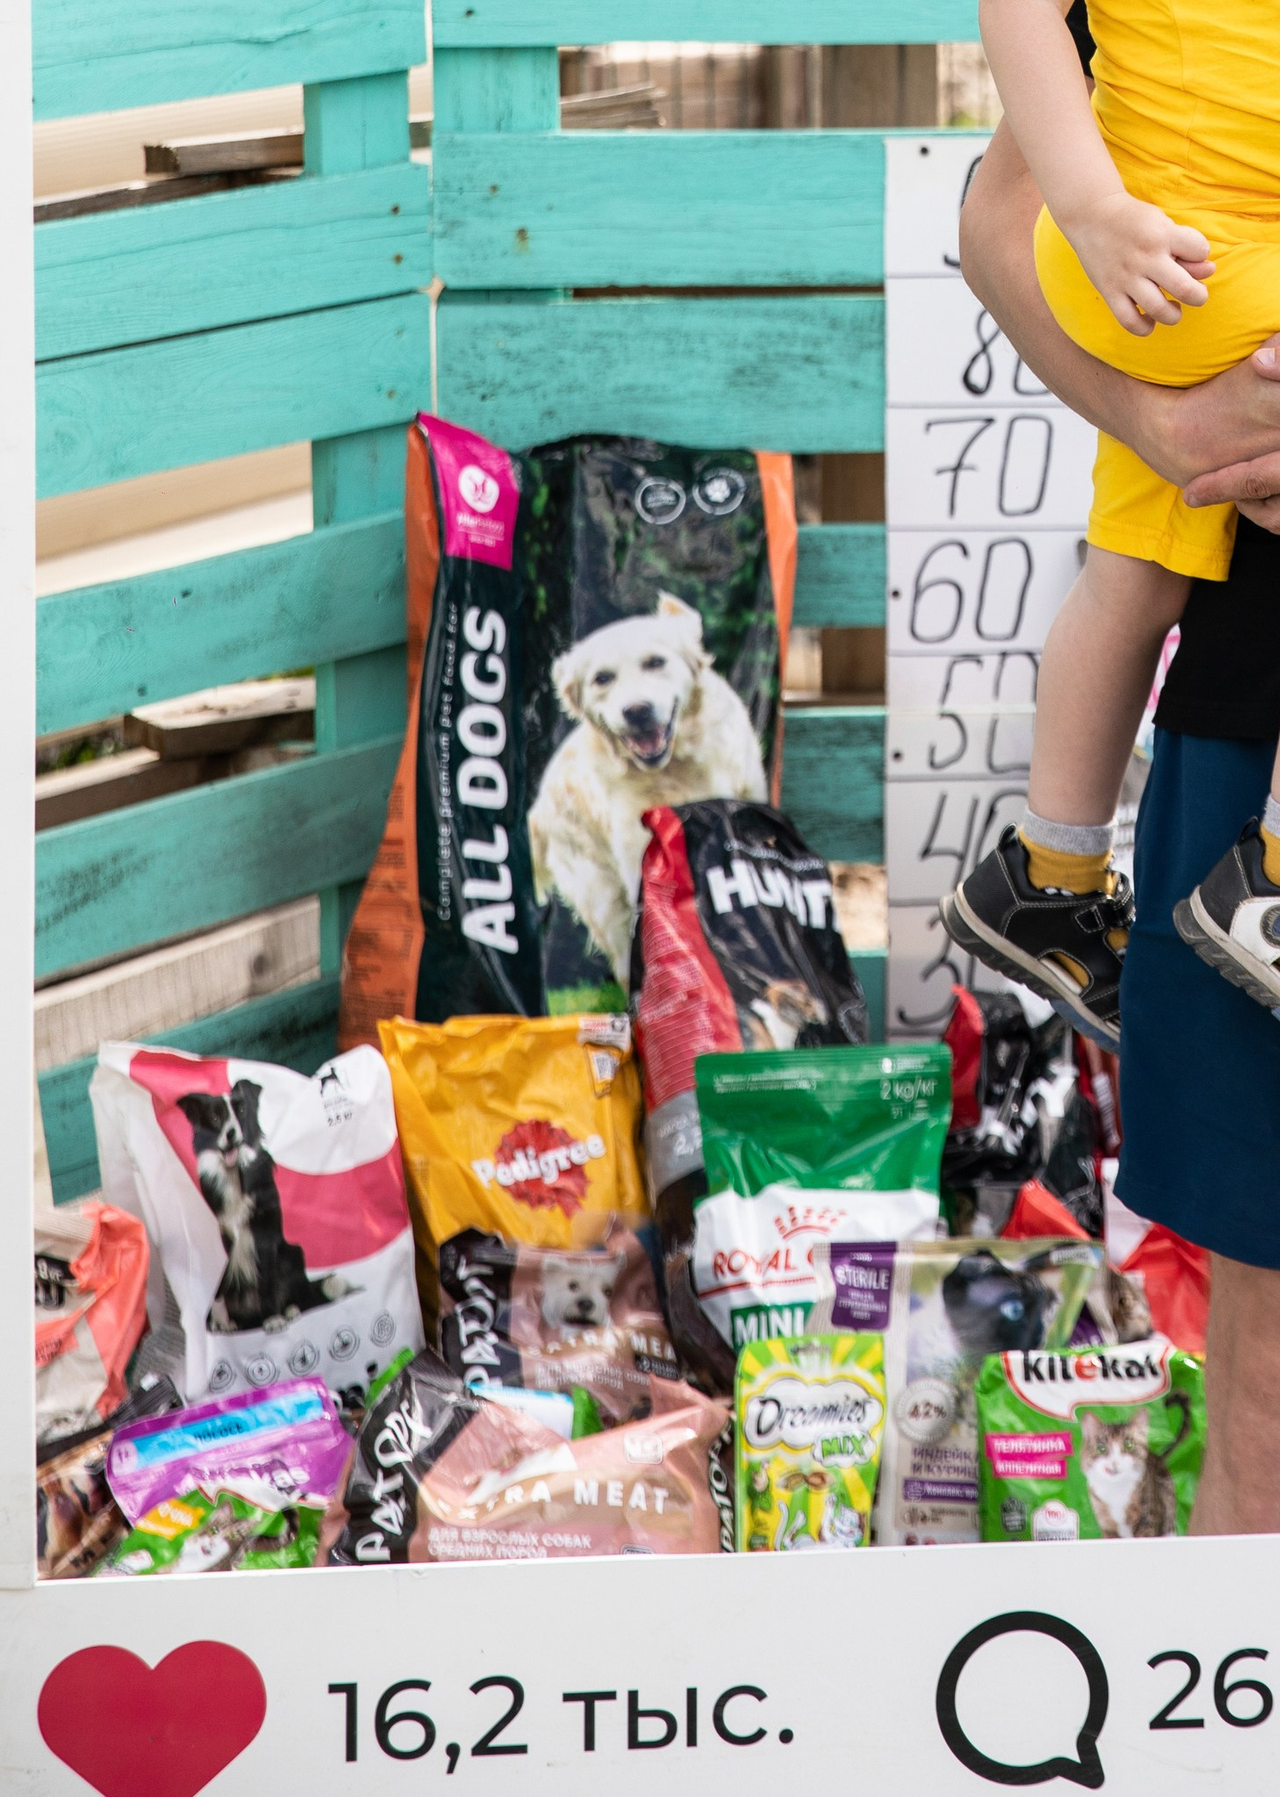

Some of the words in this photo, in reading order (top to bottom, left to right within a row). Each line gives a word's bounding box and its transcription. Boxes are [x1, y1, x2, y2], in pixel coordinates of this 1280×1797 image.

[924, 414, 1054, 519] 70
[909, 535, 1034, 644] 60
[441, 638, 456, 687] food
[439, 691, 453, 728] pet
[455, 604, 509, 811] DOGS
[439, 732, 454, 818] premium
[436, 823, 453, 921] Complete
[460, 823, 519, 955] ALL
[706, 858, 843, 933] HUNT
[470, 1133, 607, 1190] Pedigree
[713, 1248, 798, 1278] ROYAL
[833, 1263, 891, 1291] STERILE
[629, 1330, 678, 1363] MEA
[734, 1306, 805, 1346] MINI
[756, 1394, 873, 1437] Dreamies
[821, 1433, 868, 1460] MIX
[572, 1477, 669, 1515] MEAT
[428, 1526, 459, 1542] ДЛЯ
[541, 1533, 592, 1549] СОБАК
[1145, 1647, 1275, 1732] 26
[327, 1674, 529, 1774] 16,2
[562, 1684, 795, 1753] тыс.
